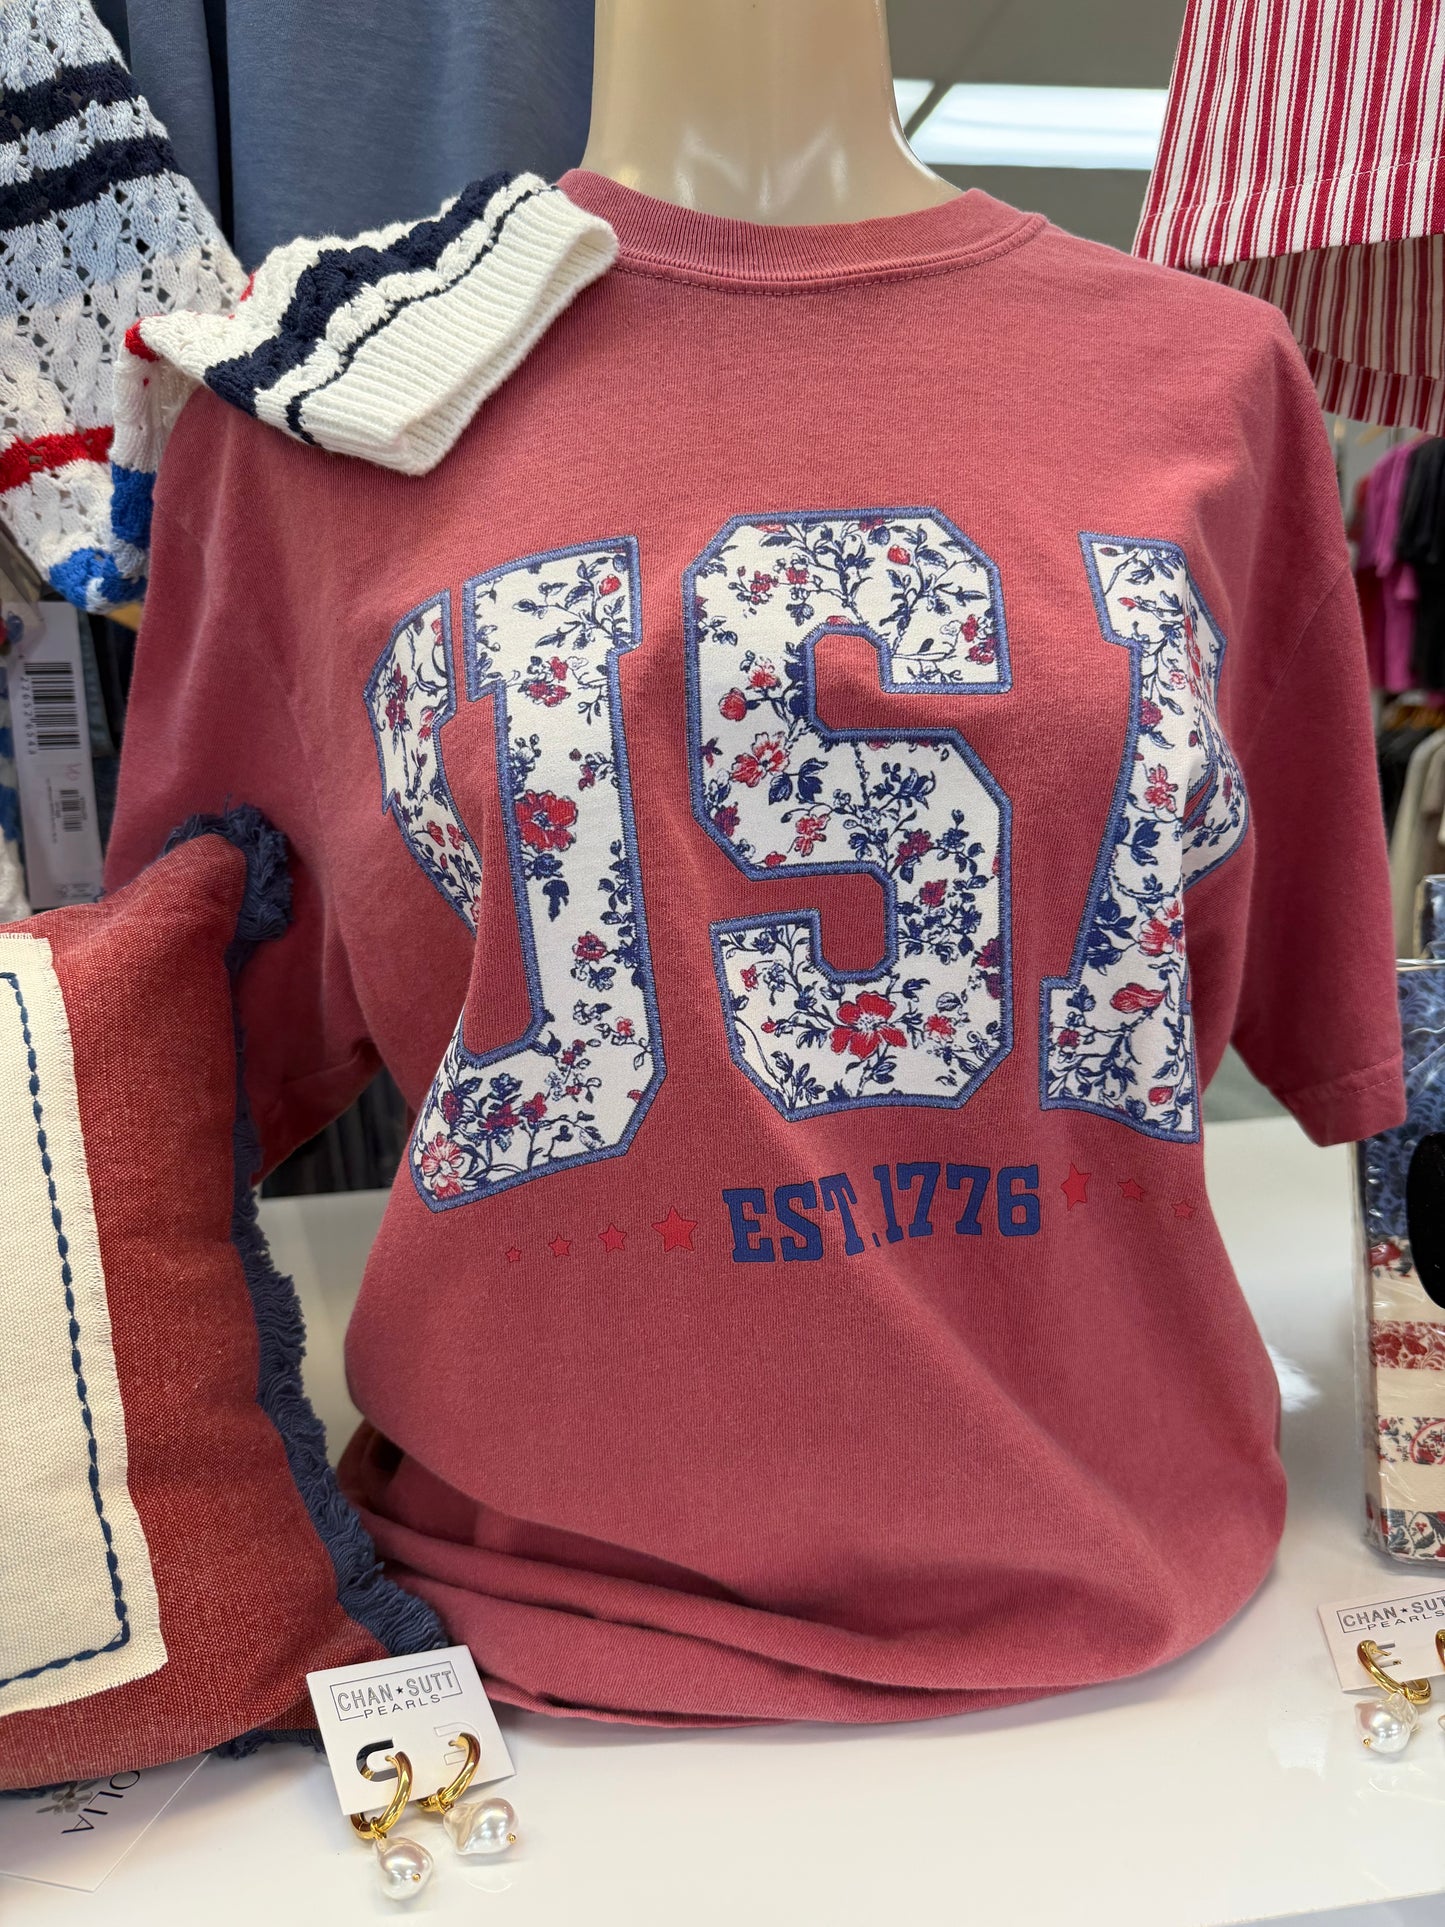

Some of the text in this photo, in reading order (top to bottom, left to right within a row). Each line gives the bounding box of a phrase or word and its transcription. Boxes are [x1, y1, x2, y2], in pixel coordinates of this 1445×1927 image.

[1342, 1605, 1398, 1628] CHAN
[1366, 1609, 1445, 1631] PEARLS
[337, 1671, 456, 1712] CHAN SUTT
[364, 1694, 442, 1719] PEARLS
